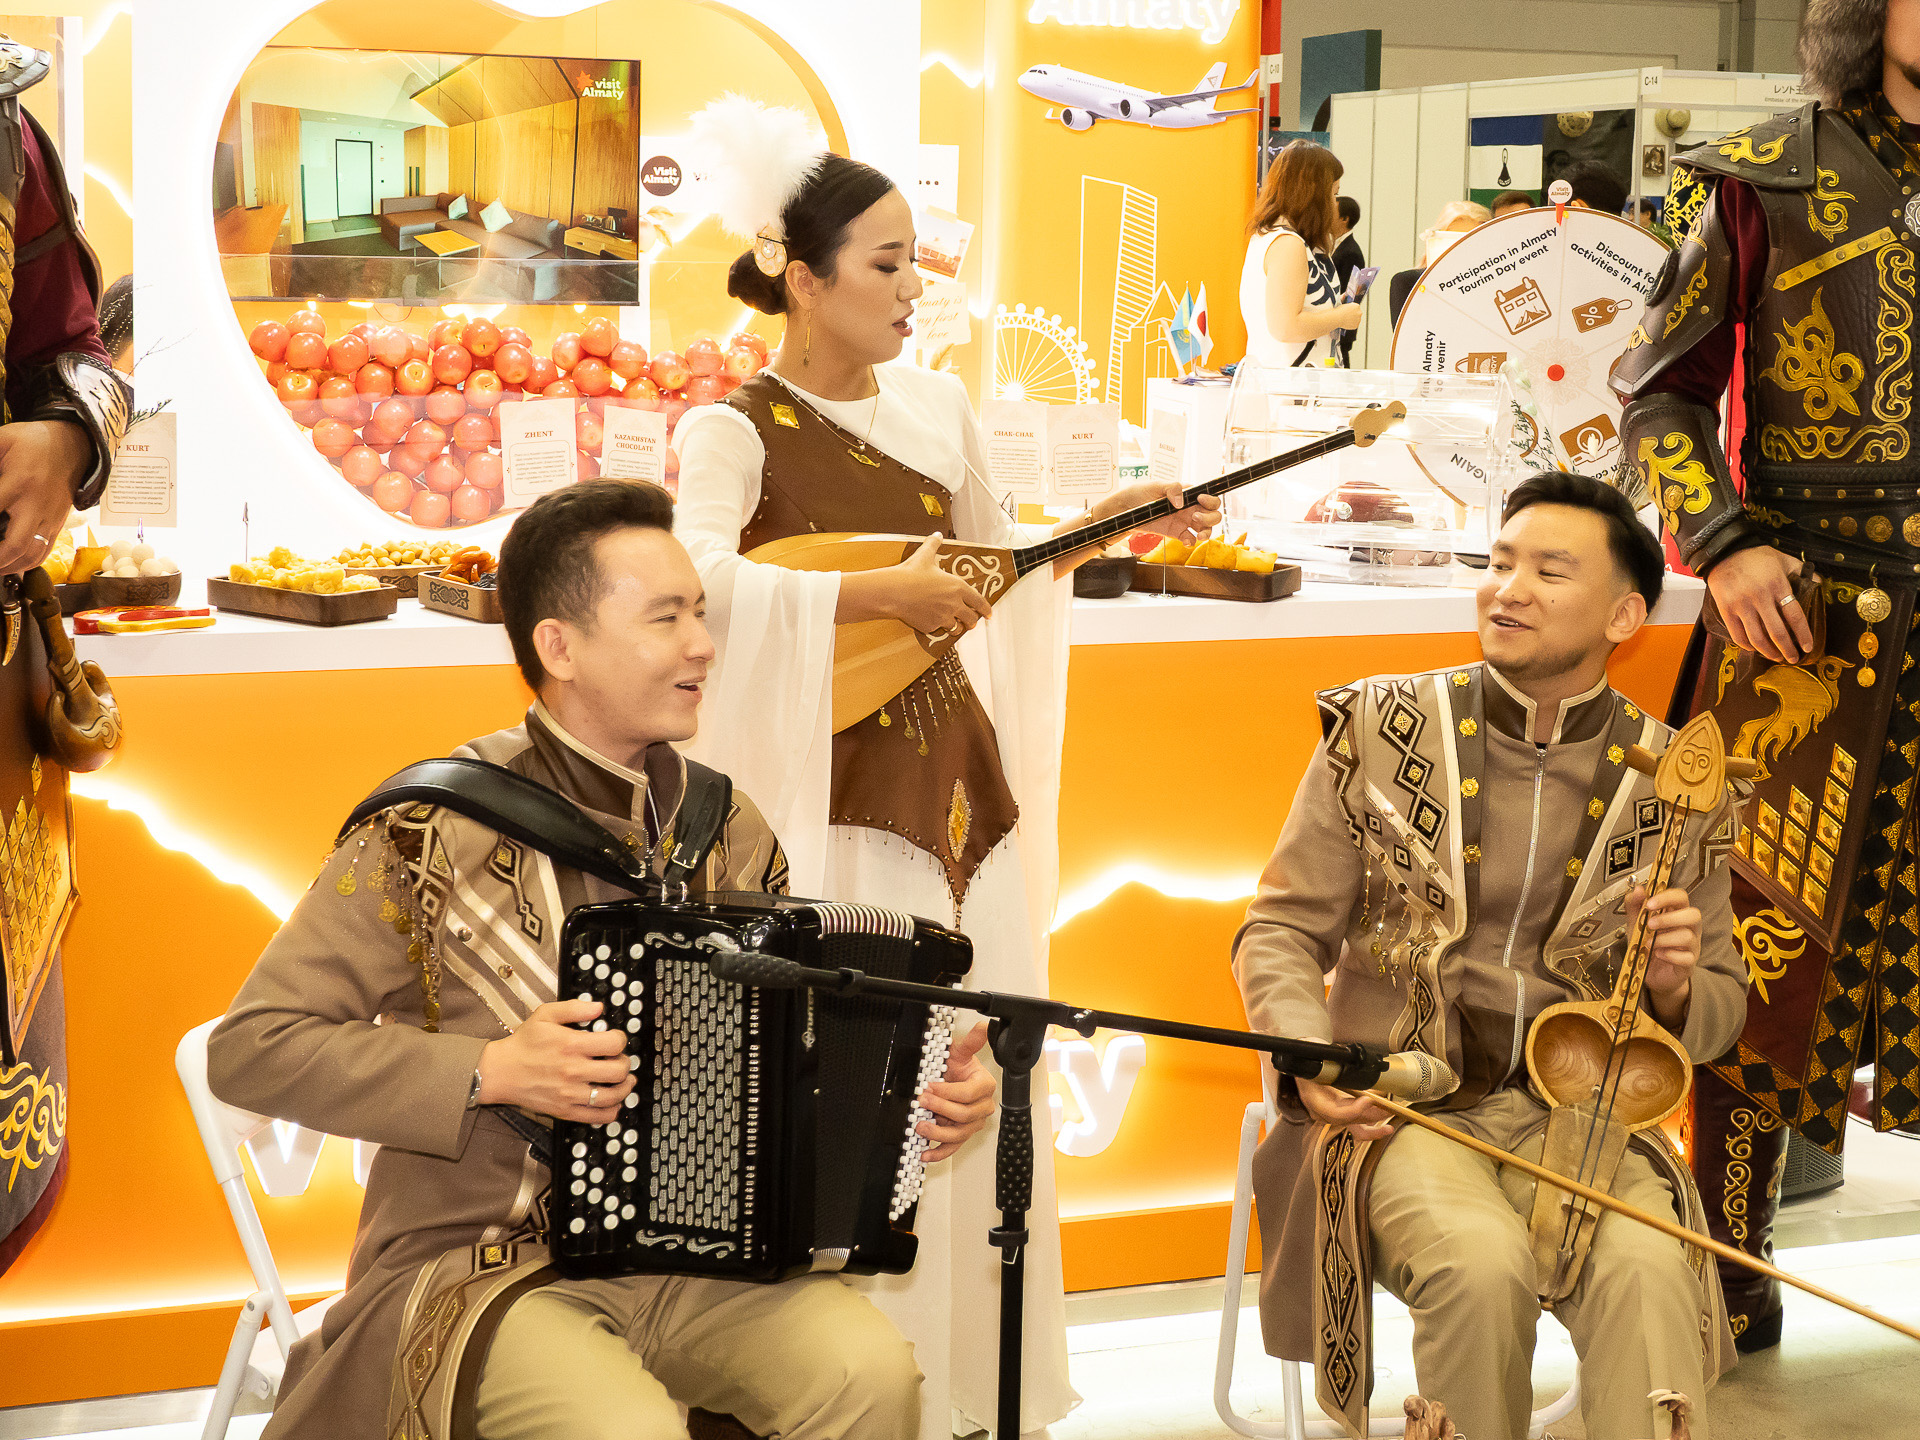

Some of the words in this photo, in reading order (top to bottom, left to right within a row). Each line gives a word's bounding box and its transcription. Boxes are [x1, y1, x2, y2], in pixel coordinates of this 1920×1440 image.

[594, 78, 621, 89] visit
[582, 87, 624, 100] Almaty
[653, 167, 678, 176] Visit
[643, 174, 680, 186] Almaty
[1438, 253, 1507, 292] Participation
[1507, 246, 1519, 257] in
[1520, 227, 1557, 250] Almaty
[1570, 243, 1619, 277] activities
[1620, 273, 1632, 285] in
[1596, 242, 1644, 276] Discount
[1644, 272, 1655, 284] fo
[1458, 273, 1494, 294] Tourim
[1495, 261, 1516, 276] Day
[1519, 244, 1549, 264] event
[918, 296, 950, 308] lmaty
[1422, 330, 1436, 372] Almaty
[524, 430, 554, 439] ZHENT
[614, 433, 656, 444] KAZAKHSTAN
[994, 430, 1034, 438] CHAK-CHAK
[126, 444, 150, 452] KURT
[616, 442, 654, 452] CHOCOLATE
